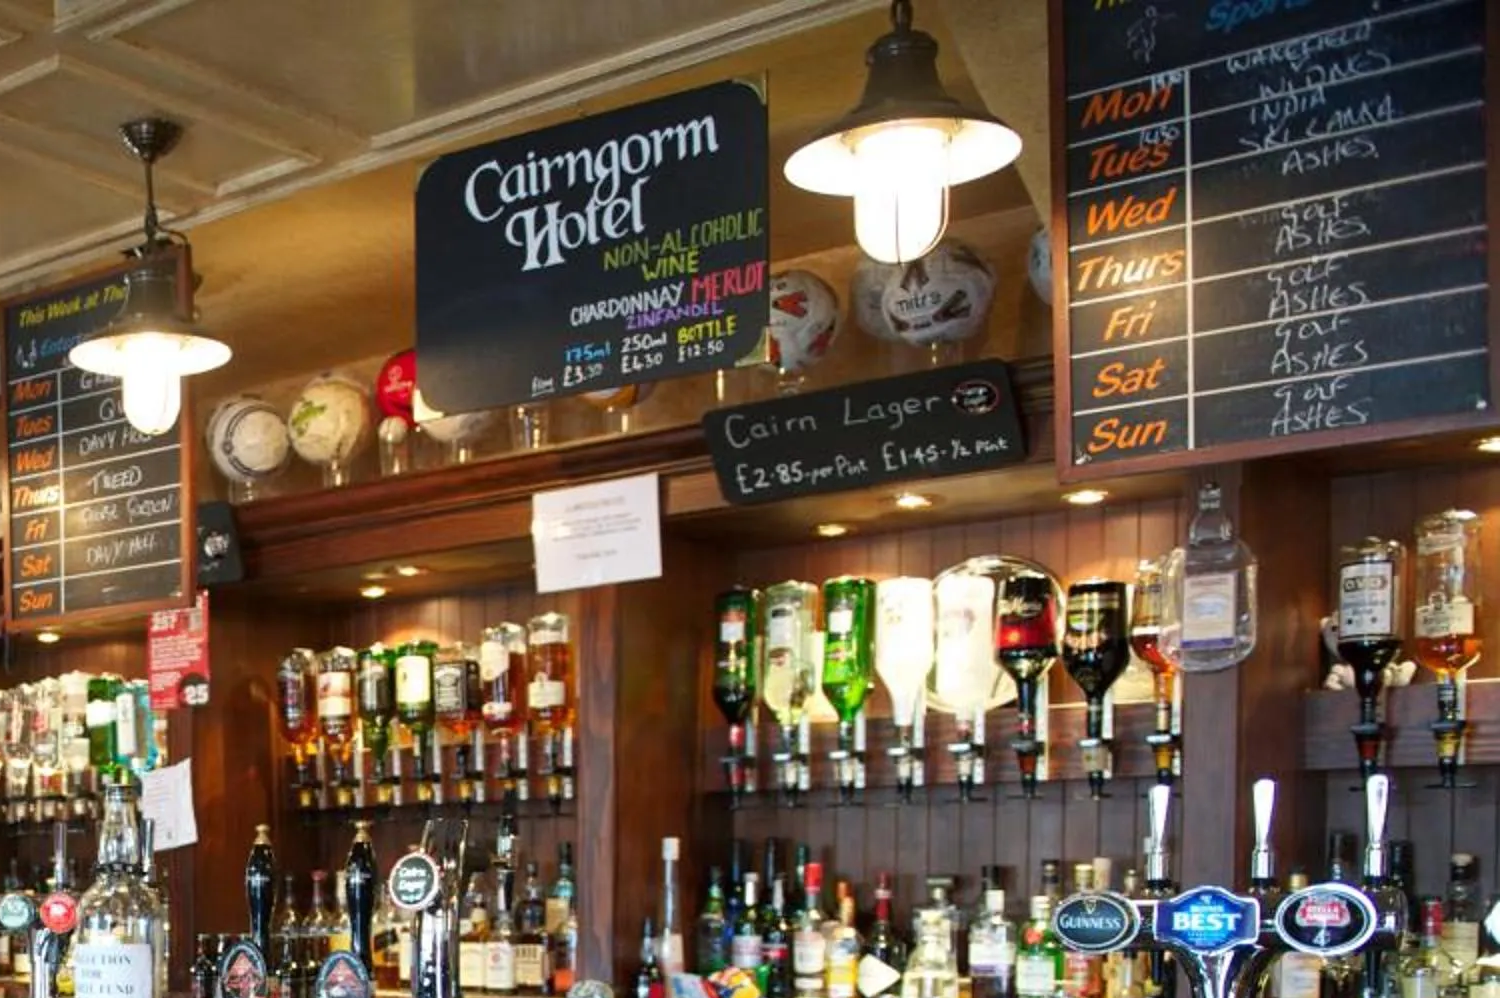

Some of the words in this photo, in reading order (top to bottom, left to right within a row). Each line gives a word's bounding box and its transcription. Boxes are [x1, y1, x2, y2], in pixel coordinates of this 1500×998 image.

[1081, 87, 1173, 128] Mon
[465, 114, 719, 222] Cairngorm
[1089, 143, 1171, 184] Tues
[505, 176, 650, 272] Hotel
[1087, 188, 1177, 236] Wed
[603, 208, 764, 271] NON-ALCOHOLIC
[641, 249, 700, 282] WINE
[691, 260, 767, 306] MERLOT
[1077, 249, 1186, 292] Thurs
[570, 280, 685, 327] CHARDONNAY
[1268, 282, 1370, 319] ASHES
[621, 332, 667, 353] 250ml
[677, 315, 737, 344] BOTTLE
[1104, 301, 1156, 341] Fri
[1271, 340, 1368, 375] ASHES
[1092, 357, 1165, 398] Sat
[725, 414, 818, 448] Cairn
[844, 397, 941, 430] Lager
[1087, 417, 1168, 455] Sun
[1269, 398, 1373, 436] ASHES
[12, 485, 60, 507] Thurs
[20, 553, 52, 577] Sat
[19, 590, 53, 612] Sun
[184, 683, 209, 705] 25
[1060, 913, 1121, 929] GUINNESS
[1172, 911, 1242, 931] BEST
